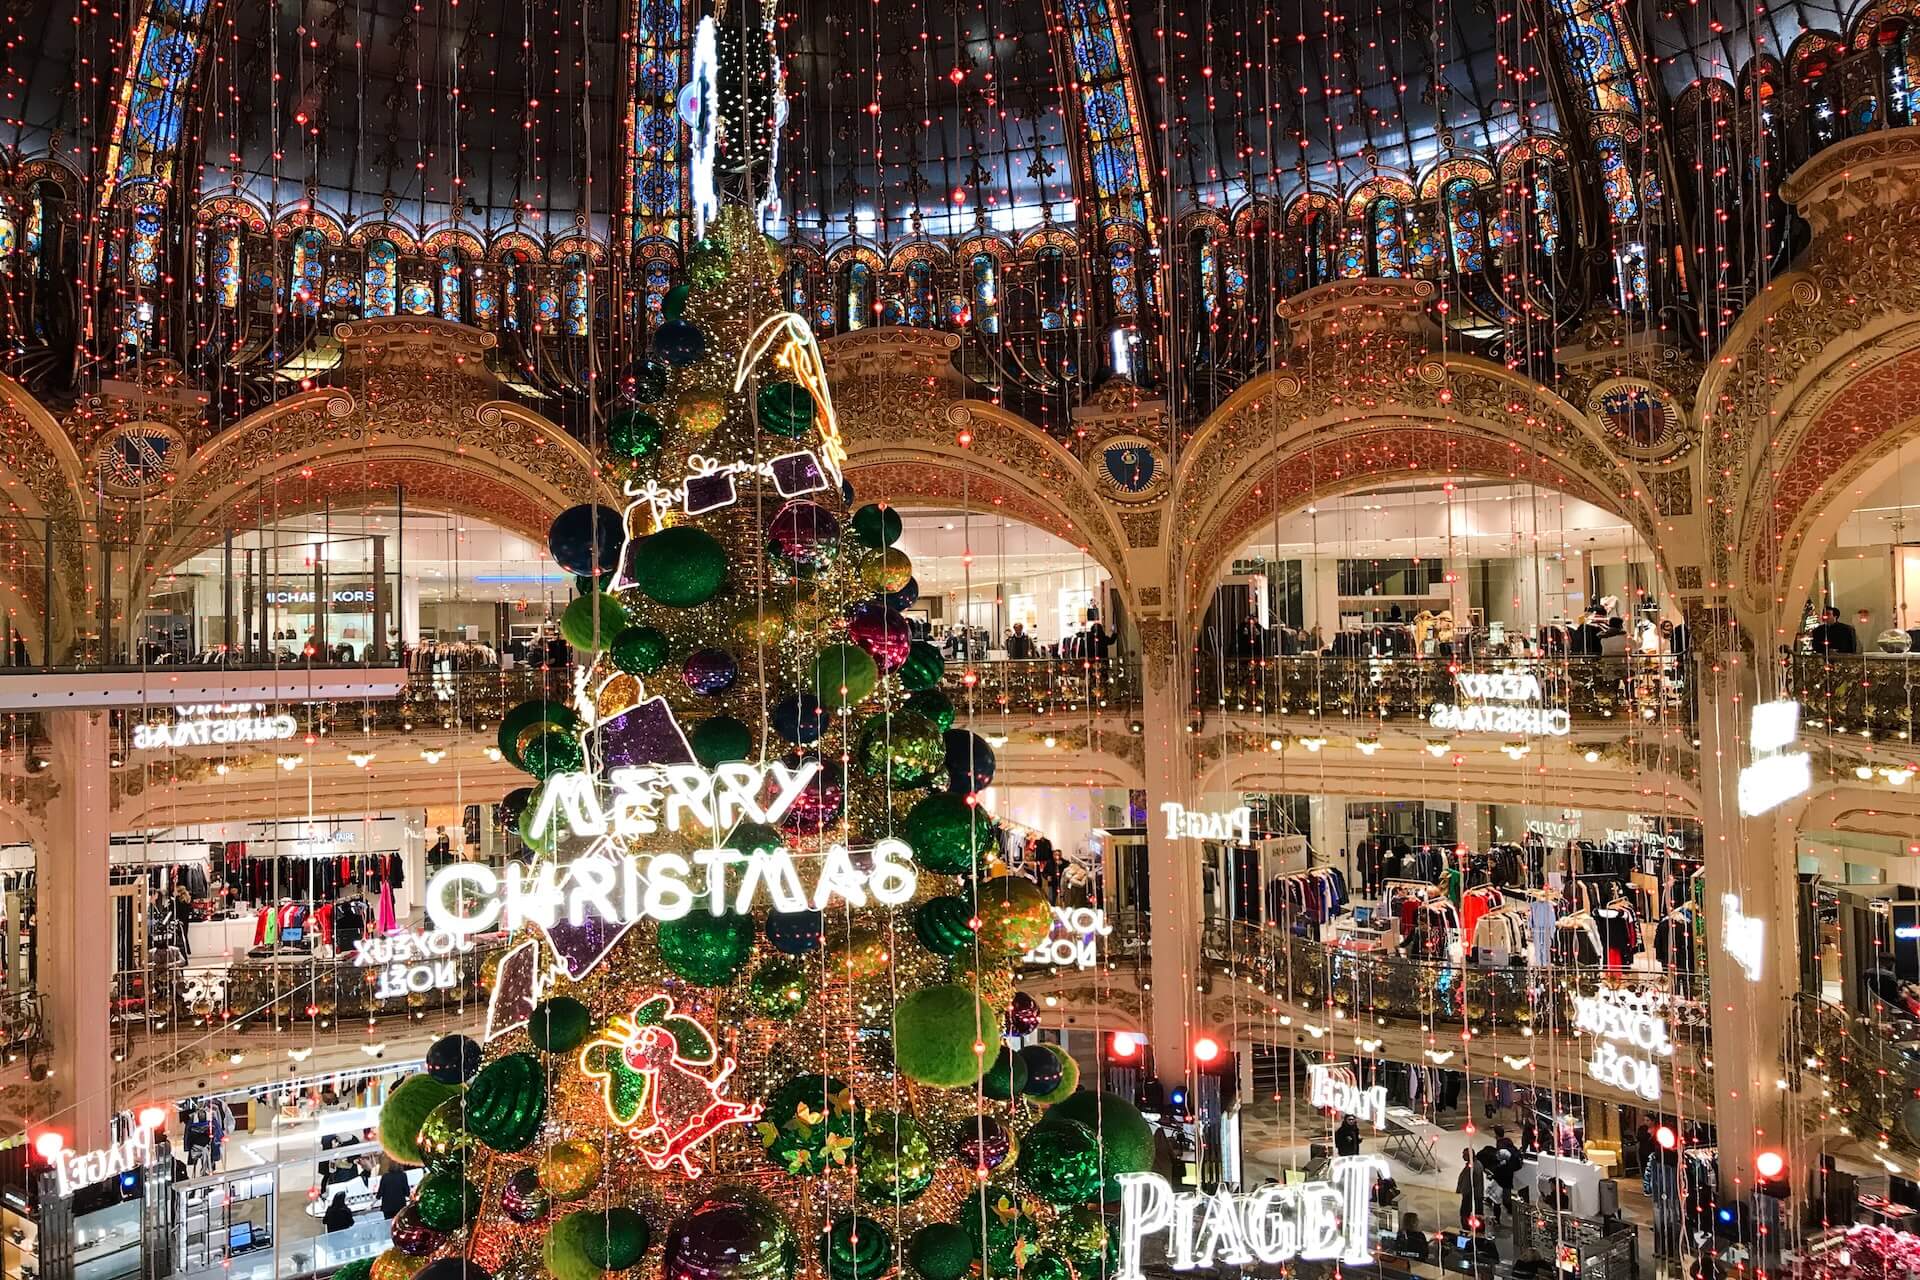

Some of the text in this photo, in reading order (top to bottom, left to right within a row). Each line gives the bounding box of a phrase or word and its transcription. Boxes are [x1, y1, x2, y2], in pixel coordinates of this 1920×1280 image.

[332, 591, 375, 602] KORS
[529, 759, 820, 840] MERRY
[426, 839, 918, 934] CHRISTMAS
[1113, 1155, 1393, 1280] PIAGET
